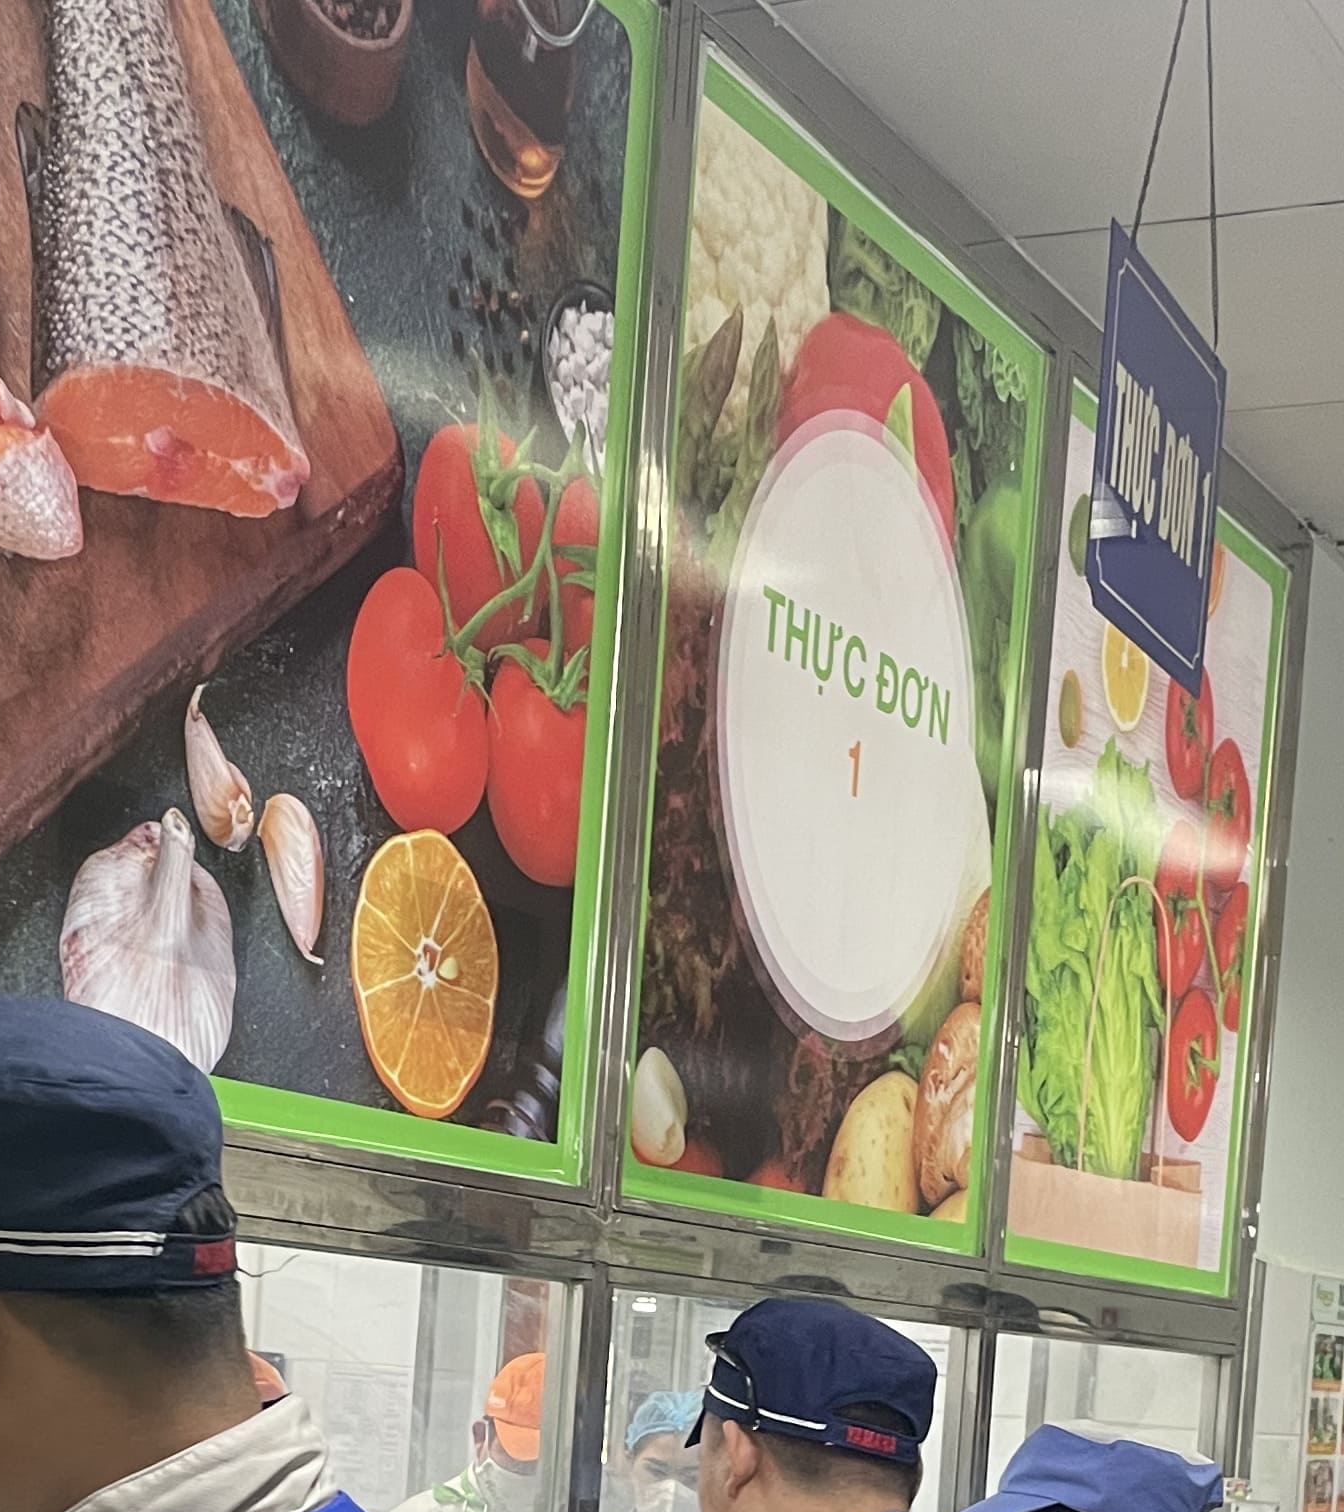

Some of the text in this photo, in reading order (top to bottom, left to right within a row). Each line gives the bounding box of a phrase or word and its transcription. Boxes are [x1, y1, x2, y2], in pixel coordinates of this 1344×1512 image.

[1110, 360, 1212, 578] THỰC ĐƠN 1
[763, 584, 950, 745] THỰC ĐƠN
[849, 740, 861, 797] 1
